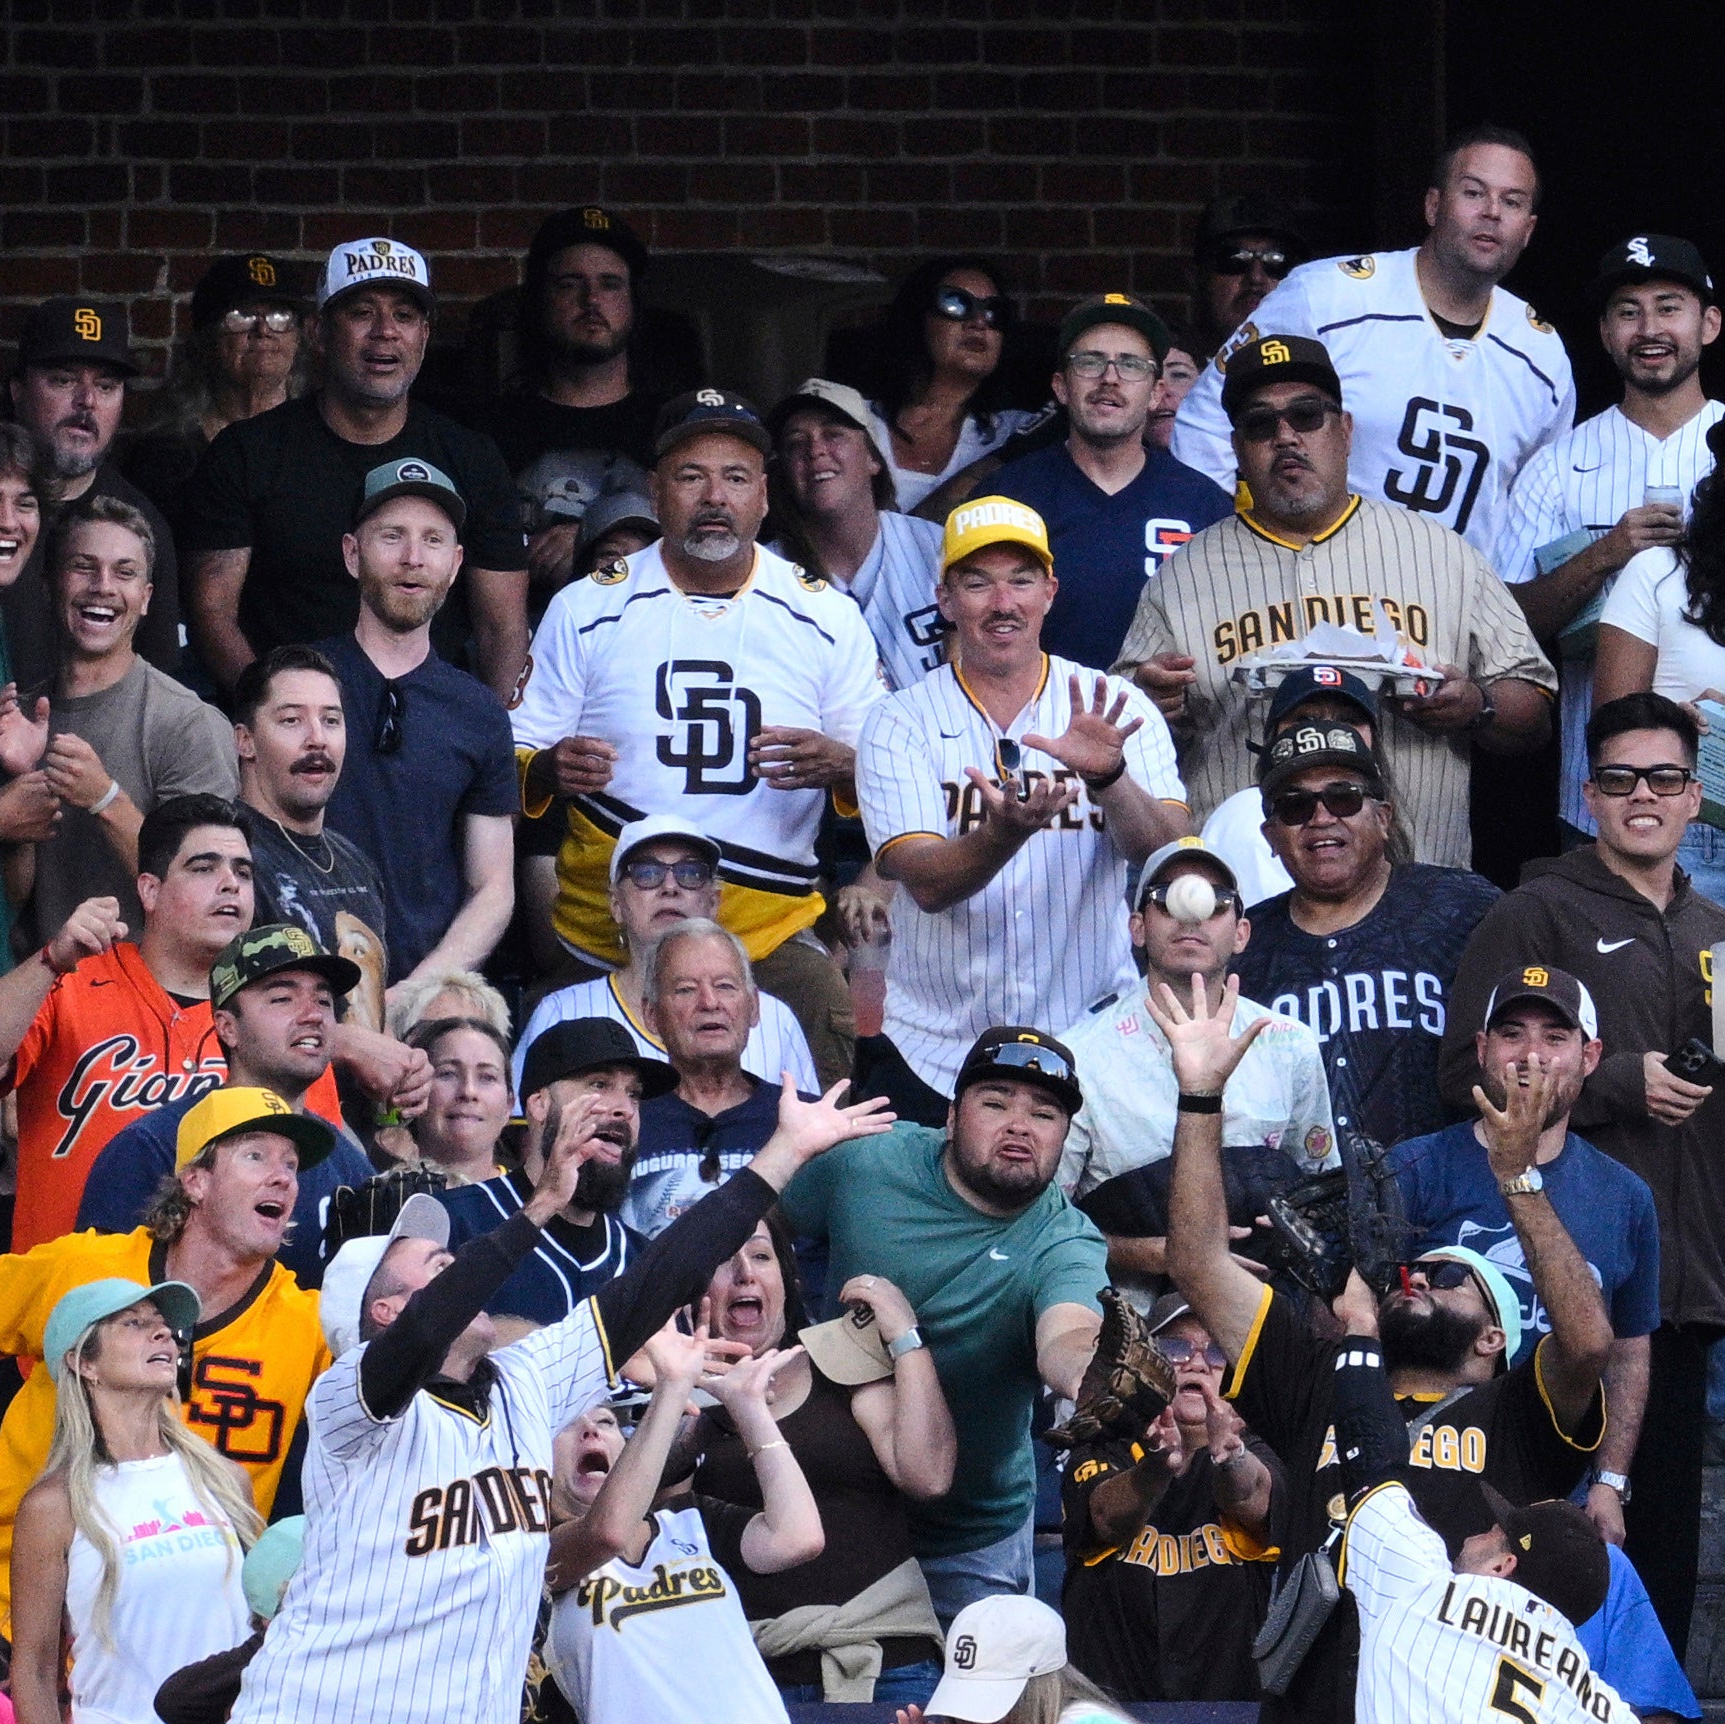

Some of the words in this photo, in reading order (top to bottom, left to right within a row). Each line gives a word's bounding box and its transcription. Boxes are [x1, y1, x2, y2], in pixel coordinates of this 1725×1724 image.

[344, 252, 416, 278] PADRES
[74, 307, 103, 342] SD
[1259, 339, 1290, 367] SD
[1383, 395, 1489, 535] SD
[954, 501, 1043, 540] PADRES
[1213, 614, 1288, 668] SAN
[1299, 596, 1428, 650] DIEGO
[1312, 665, 1343, 687] SD
[646, 657, 757, 796] SD
[1296, 727, 1326, 754] SD
[1522, 966, 1549, 988] SD
[1270, 969, 1446, 1043] ADRES
[51, 1034, 230, 1160] Gian
[188, 1354, 286, 1465] SD
[1408, 1426, 1489, 1475] EGO
[124, 1542, 174, 1568] SAN
[1155, 1522, 1234, 1579] DIEG
[575, 1565, 723, 1633] Padres
[954, 1634, 976, 1671] SD
[1436, 1581, 1611, 1724] LAUREANO
